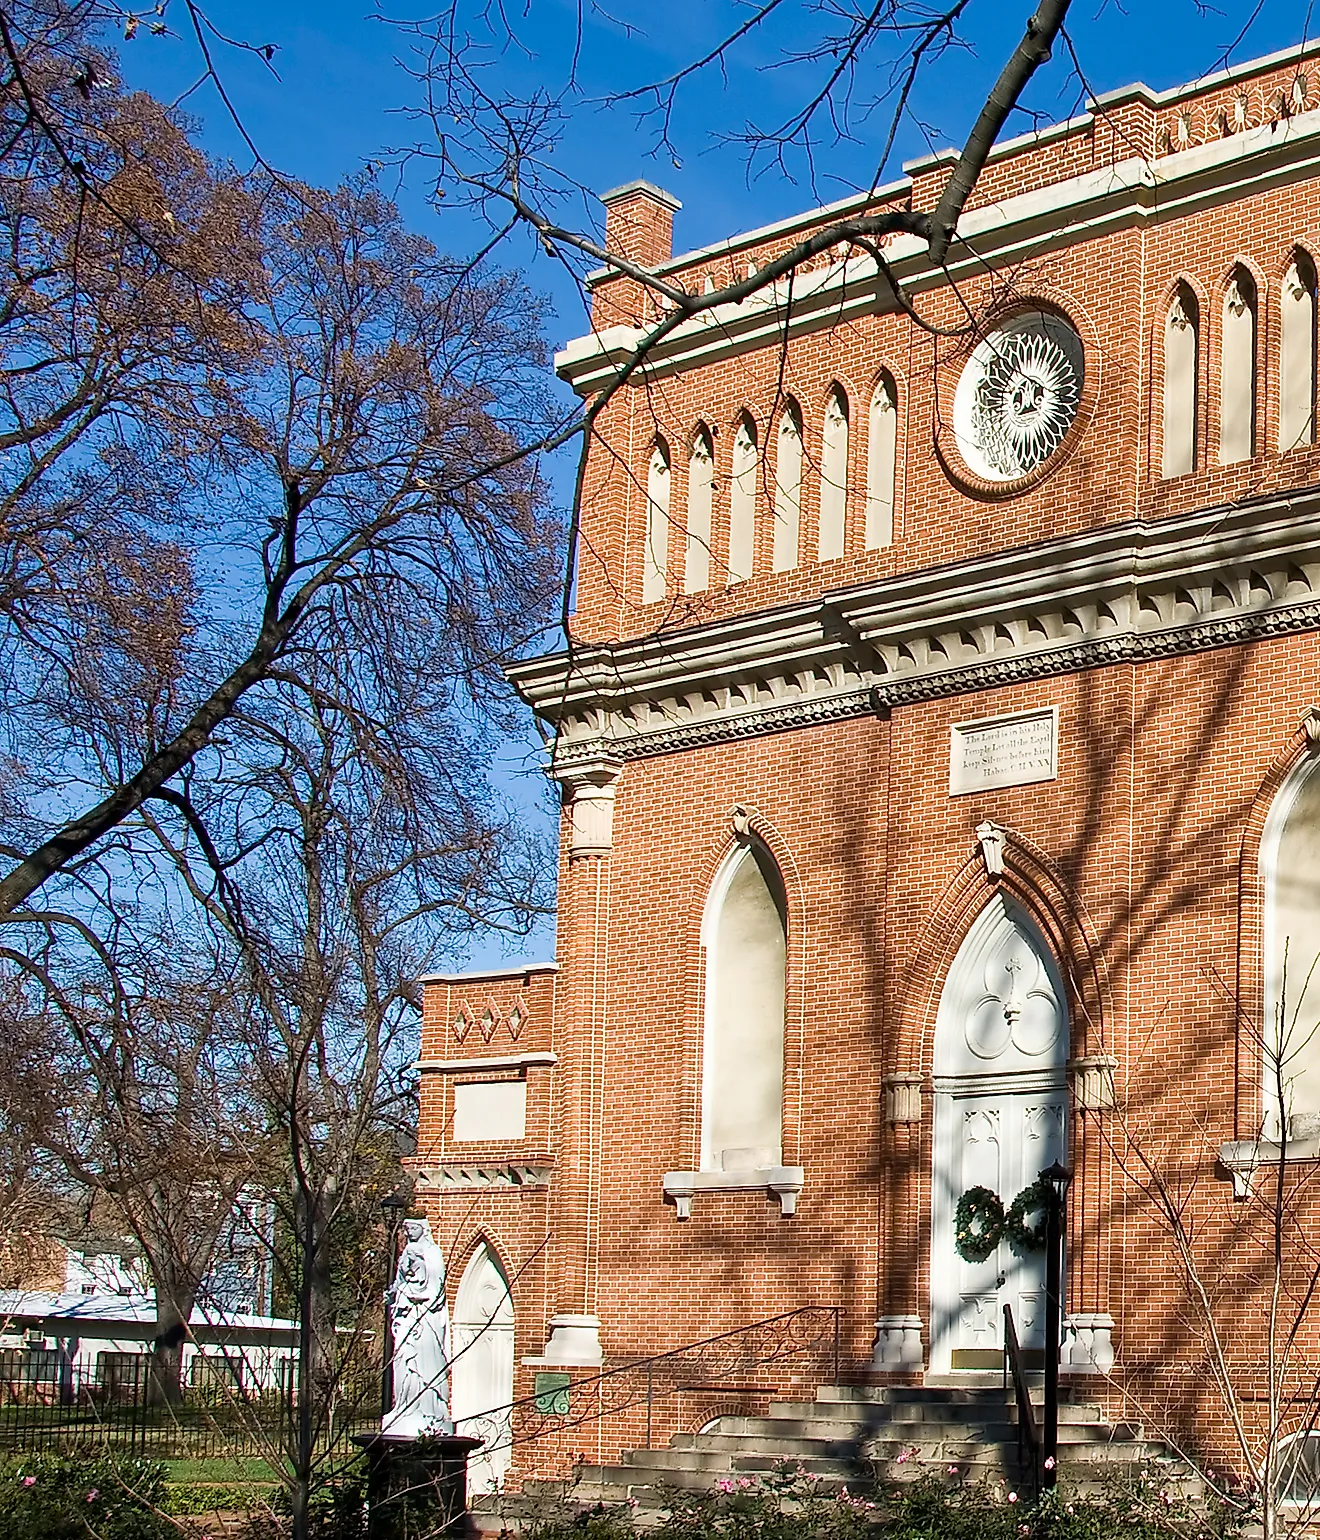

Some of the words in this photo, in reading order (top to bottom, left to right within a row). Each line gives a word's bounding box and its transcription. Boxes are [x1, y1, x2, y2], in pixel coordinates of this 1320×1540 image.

[964, 735, 980, 744] The
[981, 730, 1000, 741] Lord
[1019, 725, 1031, 734] his
[1033, 722, 1050, 732] Holy
[964, 745, 991, 756] Temple
[992, 743, 1004, 751] Let
[1009, 750, 1032, 760] before
